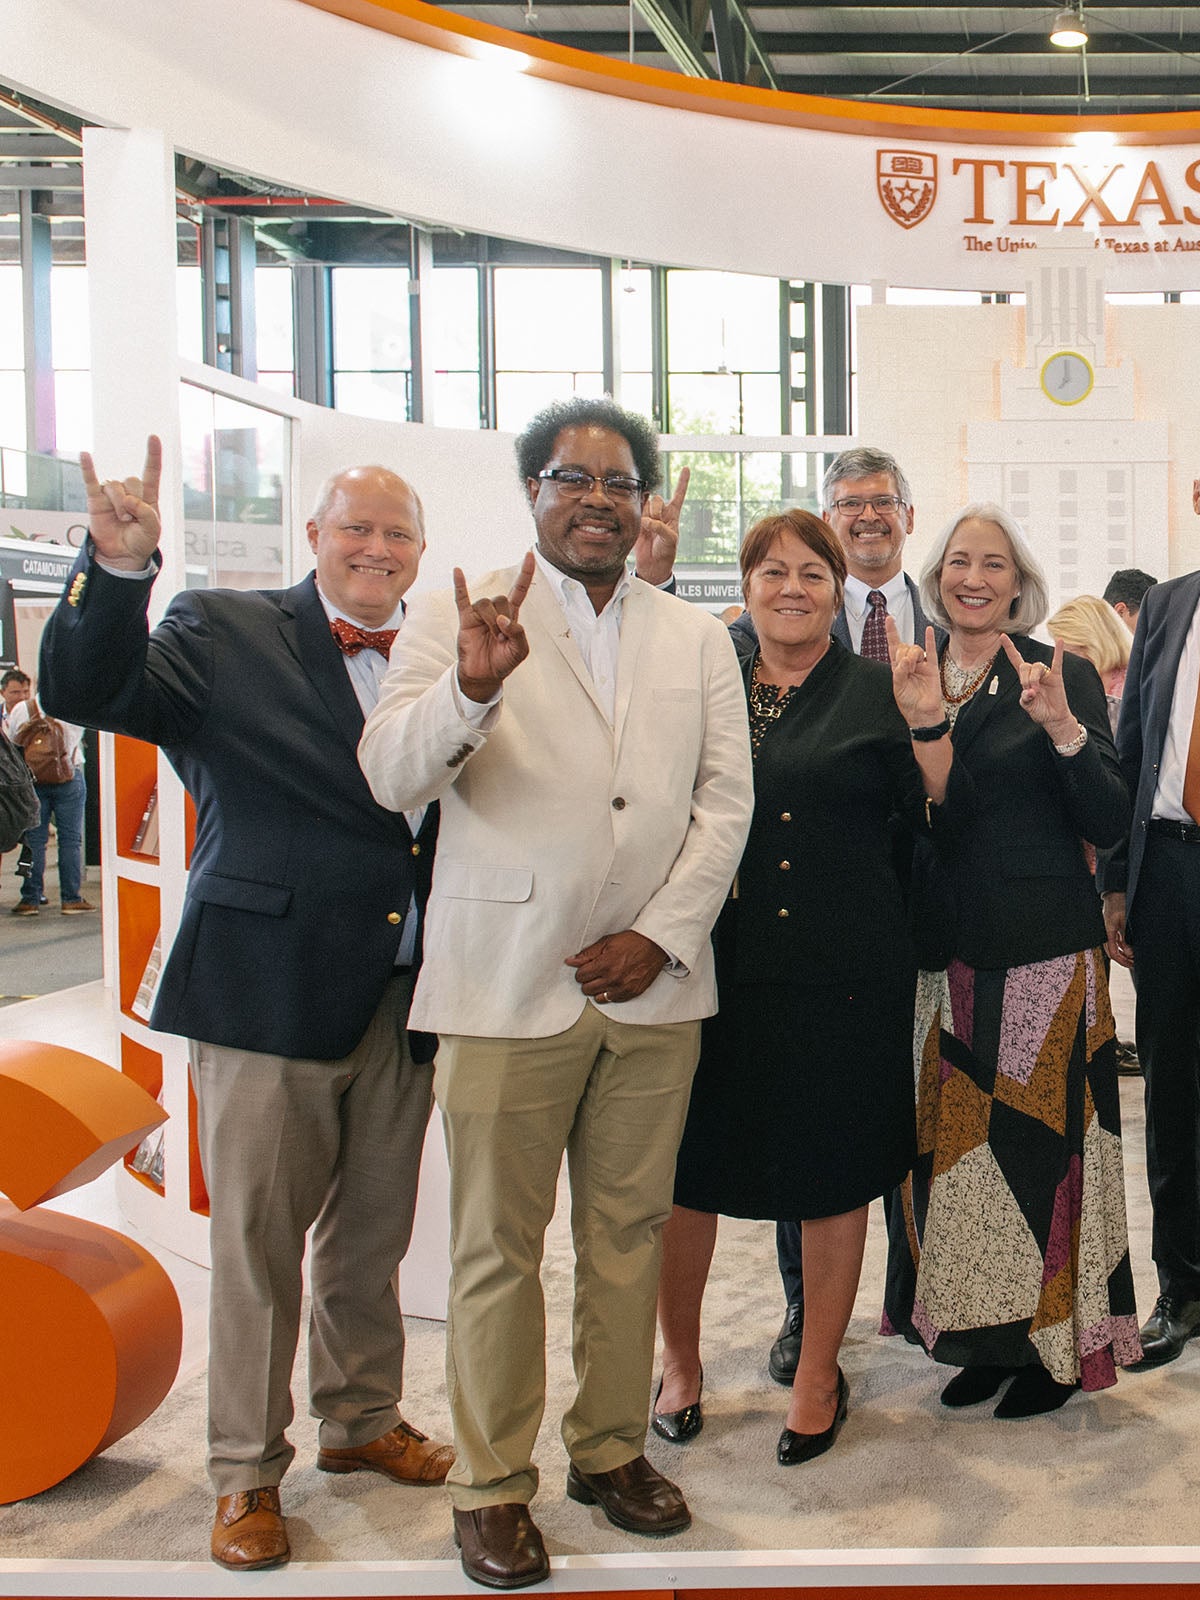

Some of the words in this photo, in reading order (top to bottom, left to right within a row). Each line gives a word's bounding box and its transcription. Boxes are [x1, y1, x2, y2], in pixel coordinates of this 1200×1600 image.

[963, 236, 993, 252] The
[1104, 237, 1150, 254] Texas
[1154, 239, 1170, 252] at
[23, 559, 68, 577] CATAMOUNT
[675, 584, 702, 597] ALES
[704, 584, 742, 597] UNIVER
